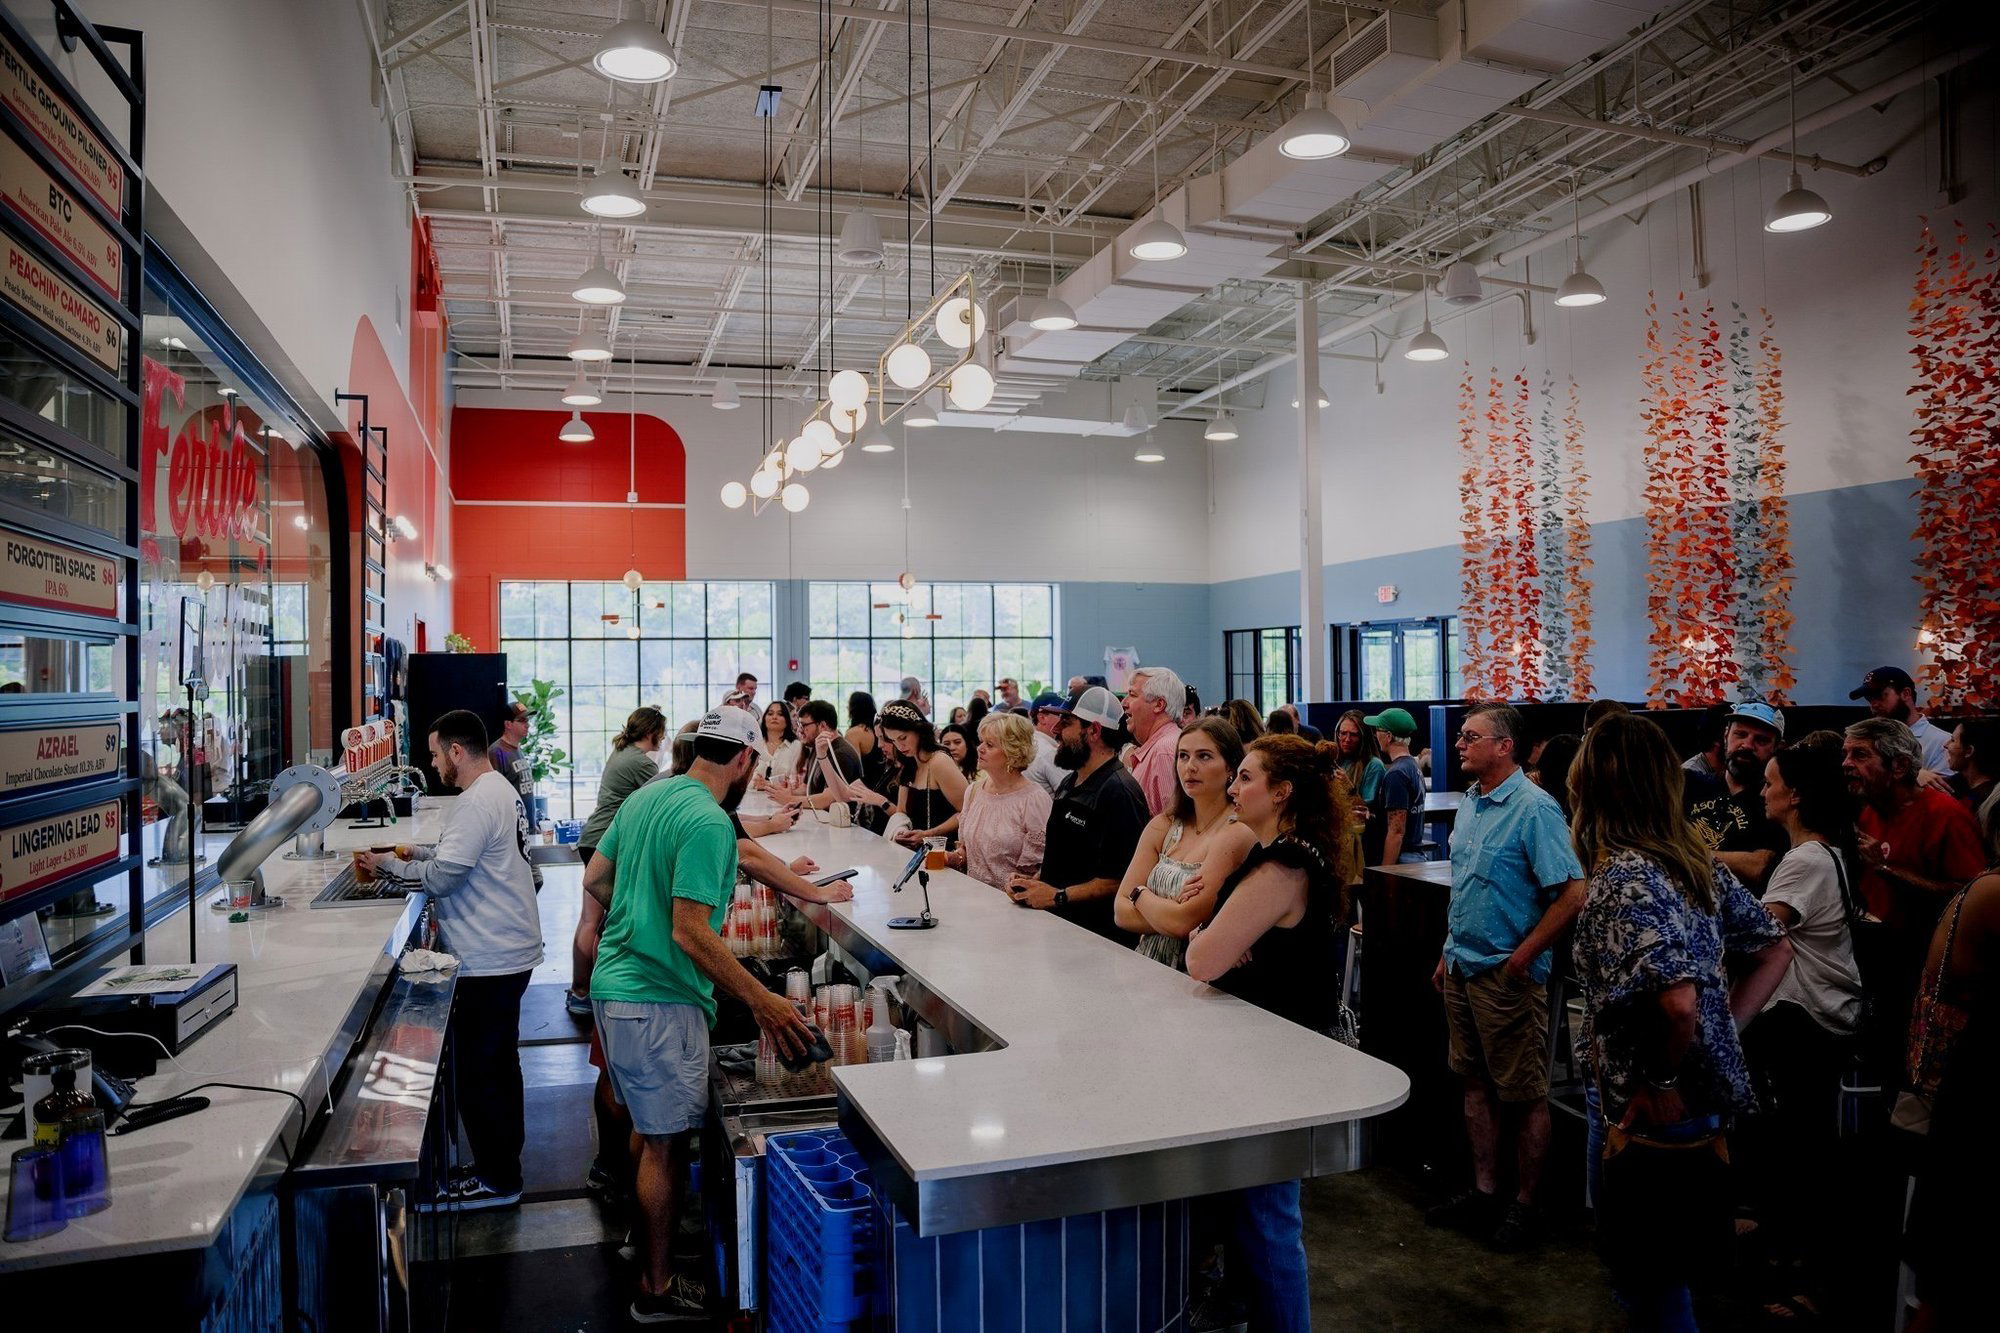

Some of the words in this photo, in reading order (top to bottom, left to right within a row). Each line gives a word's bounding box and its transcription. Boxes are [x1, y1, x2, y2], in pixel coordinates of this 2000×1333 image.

[0, 42, 36, 98] FERTILE
[38, 87, 77, 141] GROUND
[77, 130, 107, 173] PILSNER
[57, 136, 77, 165] Pilsner
[107, 167, 118, 192] $5
[49, 184, 72, 223] BTC
[18, 187, 49, 225] American
[50, 215, 62, 236] Pale
[62, 228, 73, 244] Ale
[86, 250, 98, 268] ABV
[106, 245, 117, 269] $5
[10, 248, 59, 302] PEACHIN'
[60, 290, 100, 335] CAMARO
[4, 276, 20, 297] Peach
[22, 288, 42, 312] Berliner
[54, 313, 65, 329] with
[65, 321, 82, 341] Lactose
[106, 327, 117, 349] $6
[7, 541, 67, 575] FORGOTTEN
[68, 558, 96, 581] SPACE
[45, 579, 57, 596] IPA
[59, 582, 69, 598] 6%
[102, 567, 113, 586] $6
[36, 735, 79, 760] AZRAEL
[105, 734, 116, 752] $9
[5, 768, 33, 787] Imperial
[34, 765, 63, 781] Chocolate
[64, 763, 78, 776] Stout
[79, 759, 94, 773] 10.3%
[94, 758, 106, 771] ABV
[105, 810, 115, 830] $5
[12, 818, 73, 859] LINGERING
[75, 813, 100, 839] LEAD
[29, 858, 45, 876] Light
[46, 855, 62, 872] Lager
[63, 848, 76, 864] 4.3%
[76, 843, 89, 860] ABV
